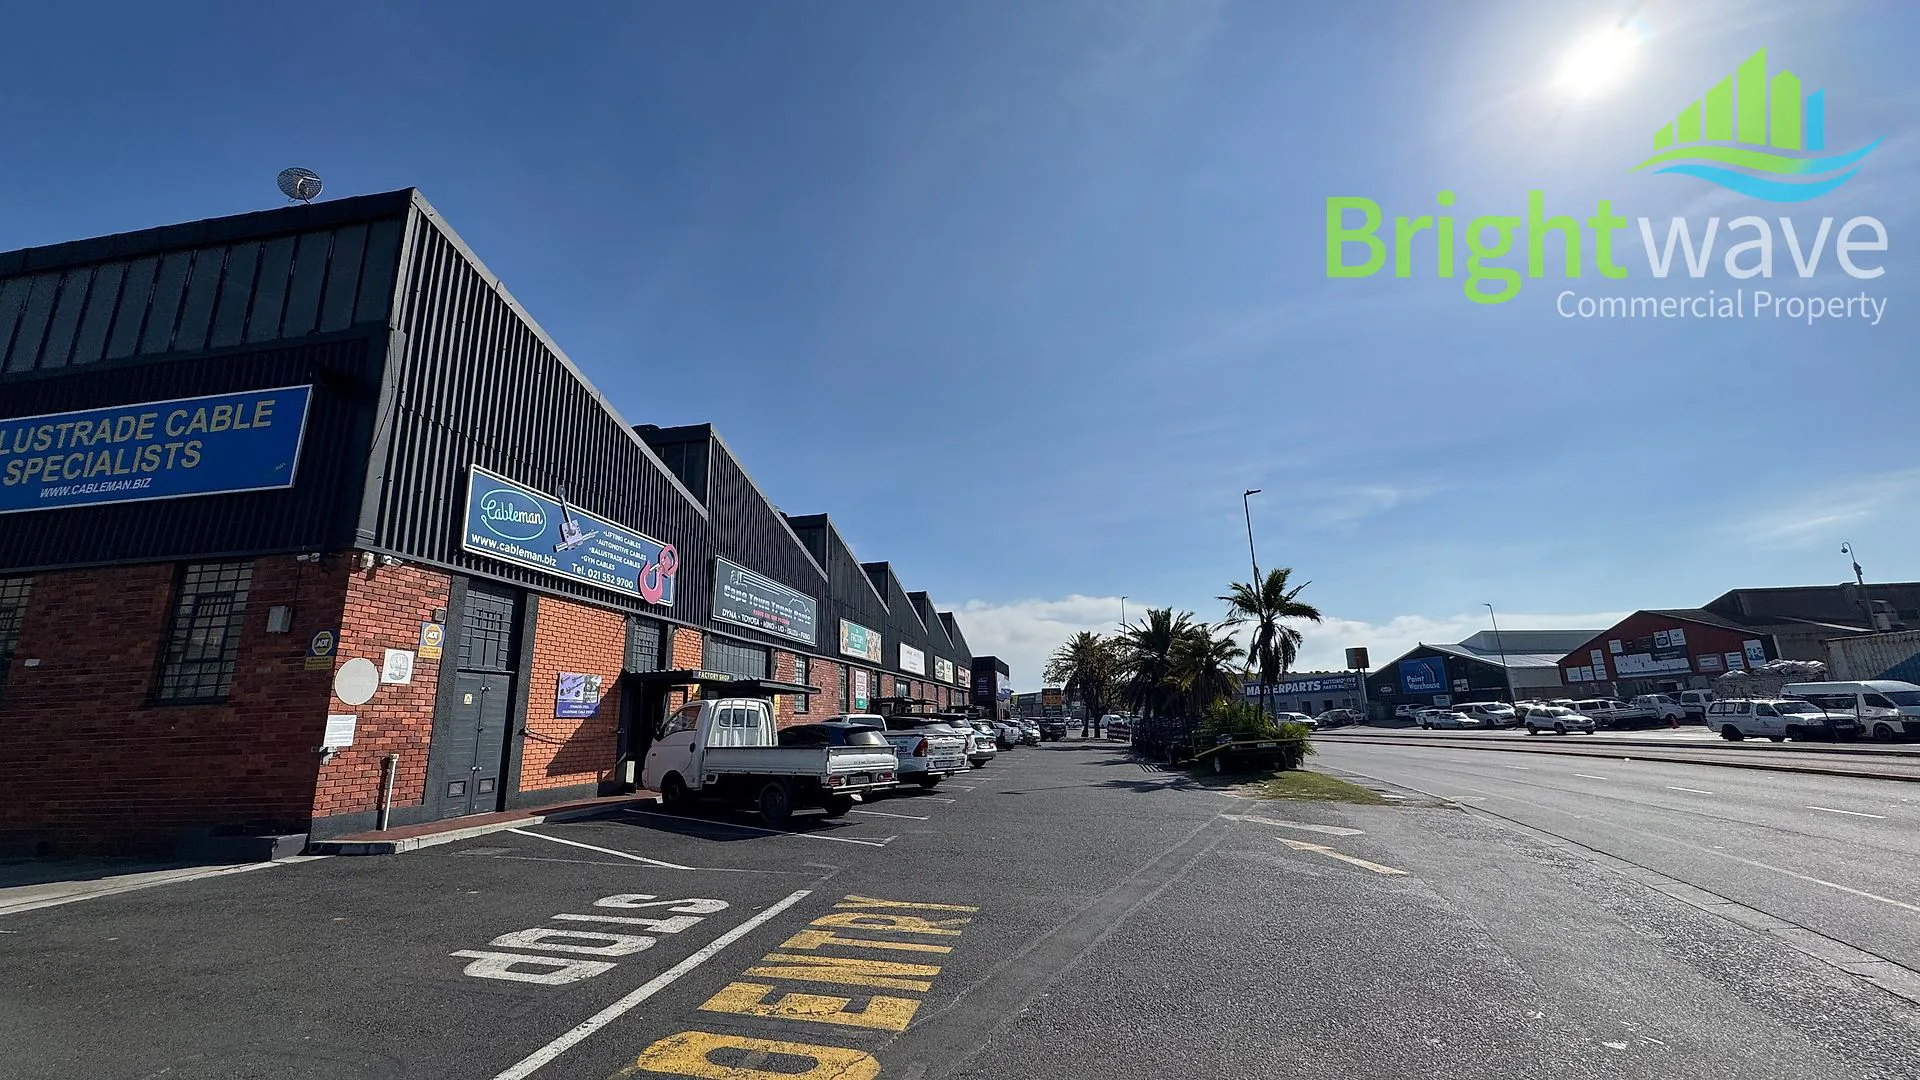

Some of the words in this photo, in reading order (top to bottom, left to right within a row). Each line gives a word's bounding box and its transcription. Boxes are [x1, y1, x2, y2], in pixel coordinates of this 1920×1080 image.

[0, 412, 158, 455] LUSTRADE
[165, 400, 275, 438] CABLE
[3, 441, 203, 487] SPECIALISTS
[39, 478, 152, 498] WWW.CABLEMAN.BIZ
[485, 499, 544, 525] Cableman
[471, 533, 557, 567] www.cableman.biz
[598, 539, 629, 555] AUTOMOTIVE
[629, 550, 647, 561] CABLES
[604, 530, 624, 543] LIFTING
[624, 538, 641, 549] CABLES
[583, 555, 596, 565] GYM
[596, 559, 615, 571] CABLES
[590, 547, 623, 563] BALUSTRADE
[623, 558, 641, 569] CABLES
[571, 563, 586, 576] Tel.
[587, 569, 601, 580] 021
[601, 573, 615, 585] 552
[616, 577, 634, 590] 9700
[721, 608, 737, 620] DYNA
[741, 614, 760, 626] TOYOTA
[315, 639, 330, 648] ADT
[427, 631, 439, 639] ADT
[698, 671, 719, 681] FACTORY
[719, 674, 730, 682] SHOP
[1406, 675, 1425, 684] Paint
[1407, 682, 1441, 690] Warehouse
[448, 893, 730, 986] STOP
[697, 893, 980, 1032] ENTRY
